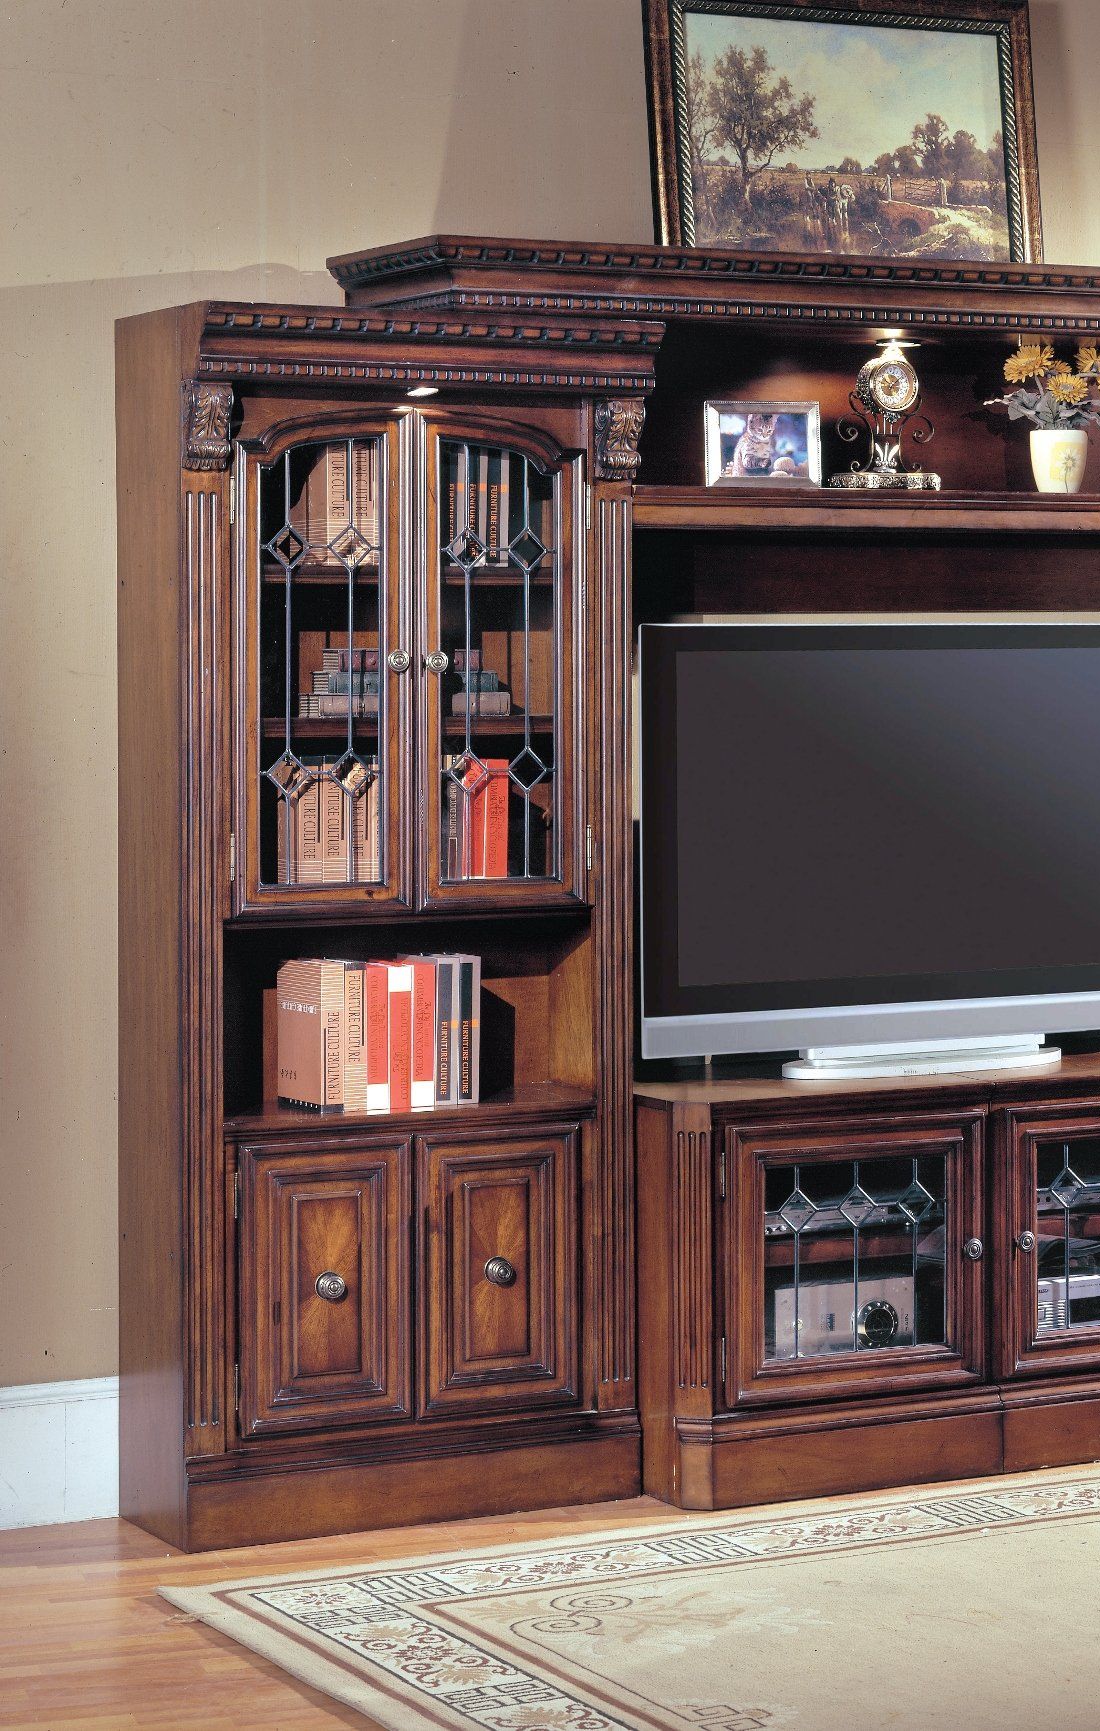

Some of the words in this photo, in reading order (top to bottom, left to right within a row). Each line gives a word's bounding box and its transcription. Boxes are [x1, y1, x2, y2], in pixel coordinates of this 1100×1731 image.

[332, 478, 344, 518] CULTURE
[355, 480, 368, 517] CULTURE
[469, 484, 477, 524] FURNITURE
[490, 484, 498, 524] FURNITURE
[304, 820, 316, 859] CULTURE
[328, 818, 340, 856] CULTURE
[348, 974, 360, 1022] FURNITURE
[328, 1012, 340, 1050] CULTURE
[348, 1024, 360, 1062] CULTURE
[328, 1052, 340, 1100] FURNITURE
